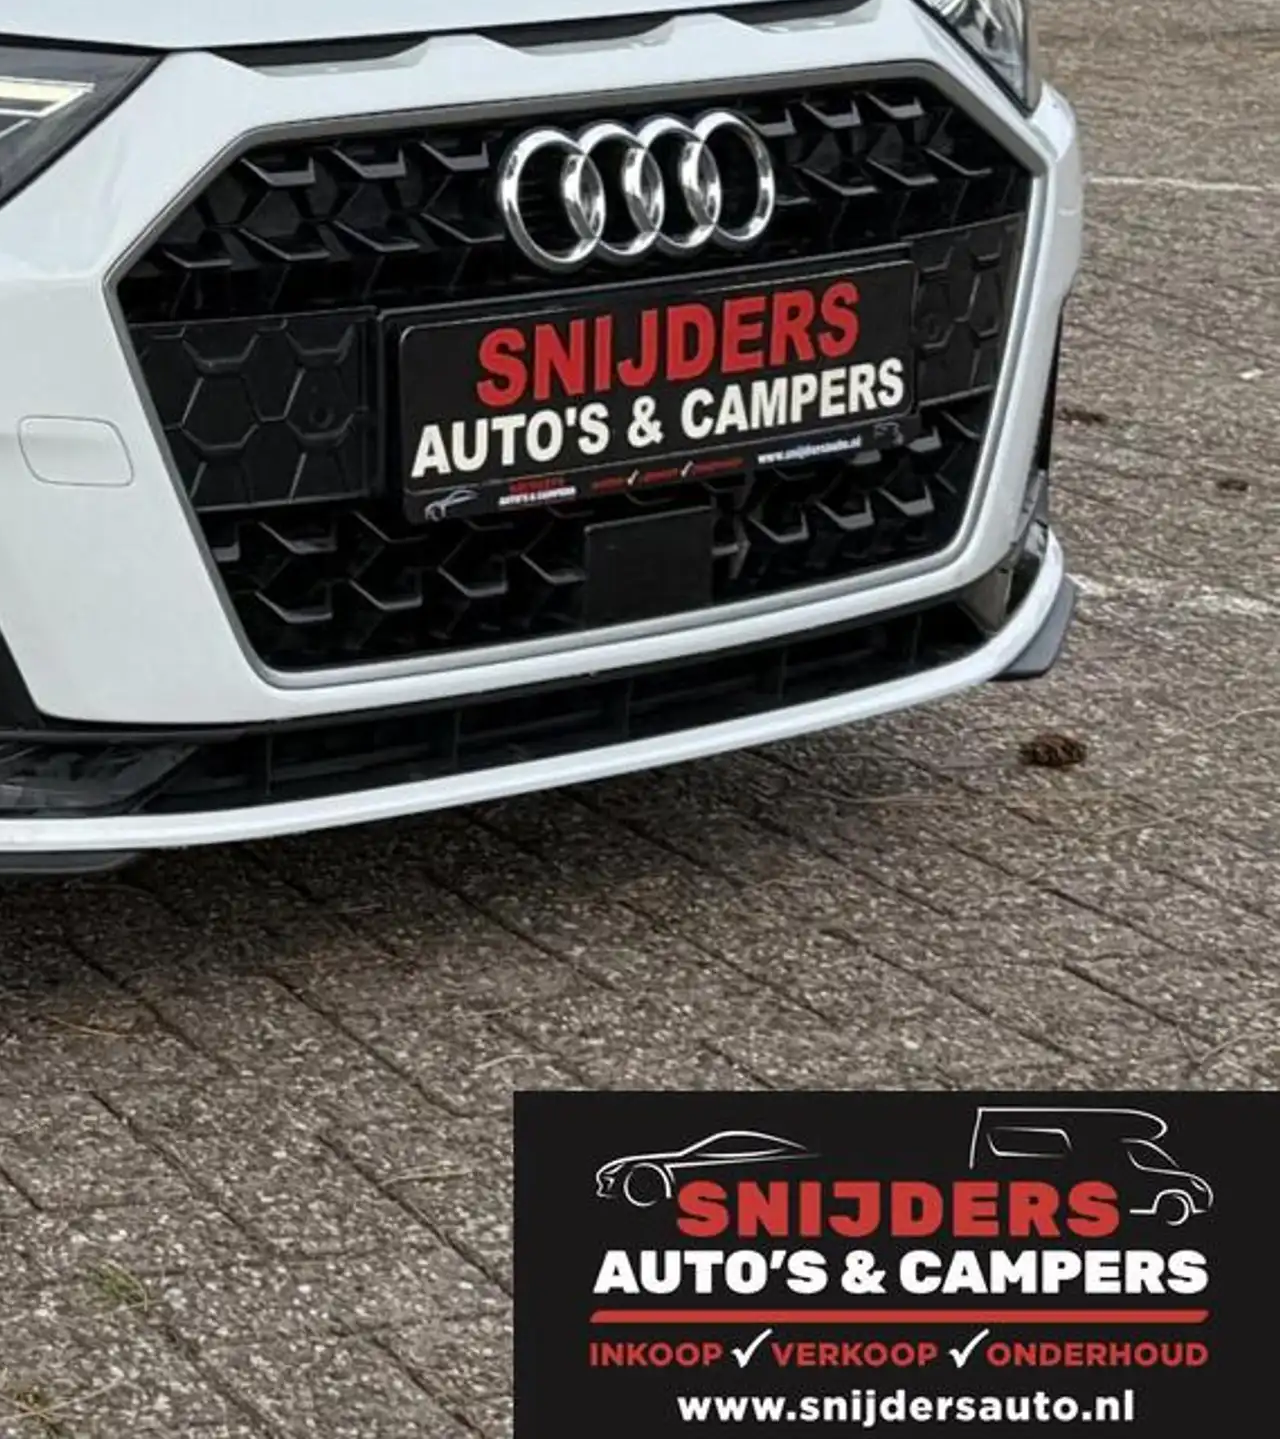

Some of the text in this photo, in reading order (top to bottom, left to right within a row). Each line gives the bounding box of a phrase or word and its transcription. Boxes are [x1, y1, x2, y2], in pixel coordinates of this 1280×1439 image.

[476, 282, 860, 408] SNIJDERS
[411, 402, 610, 478] AUTO'S
[627, 395, 664, 448] &
[681, 357, 904, 442] CAMPERS
